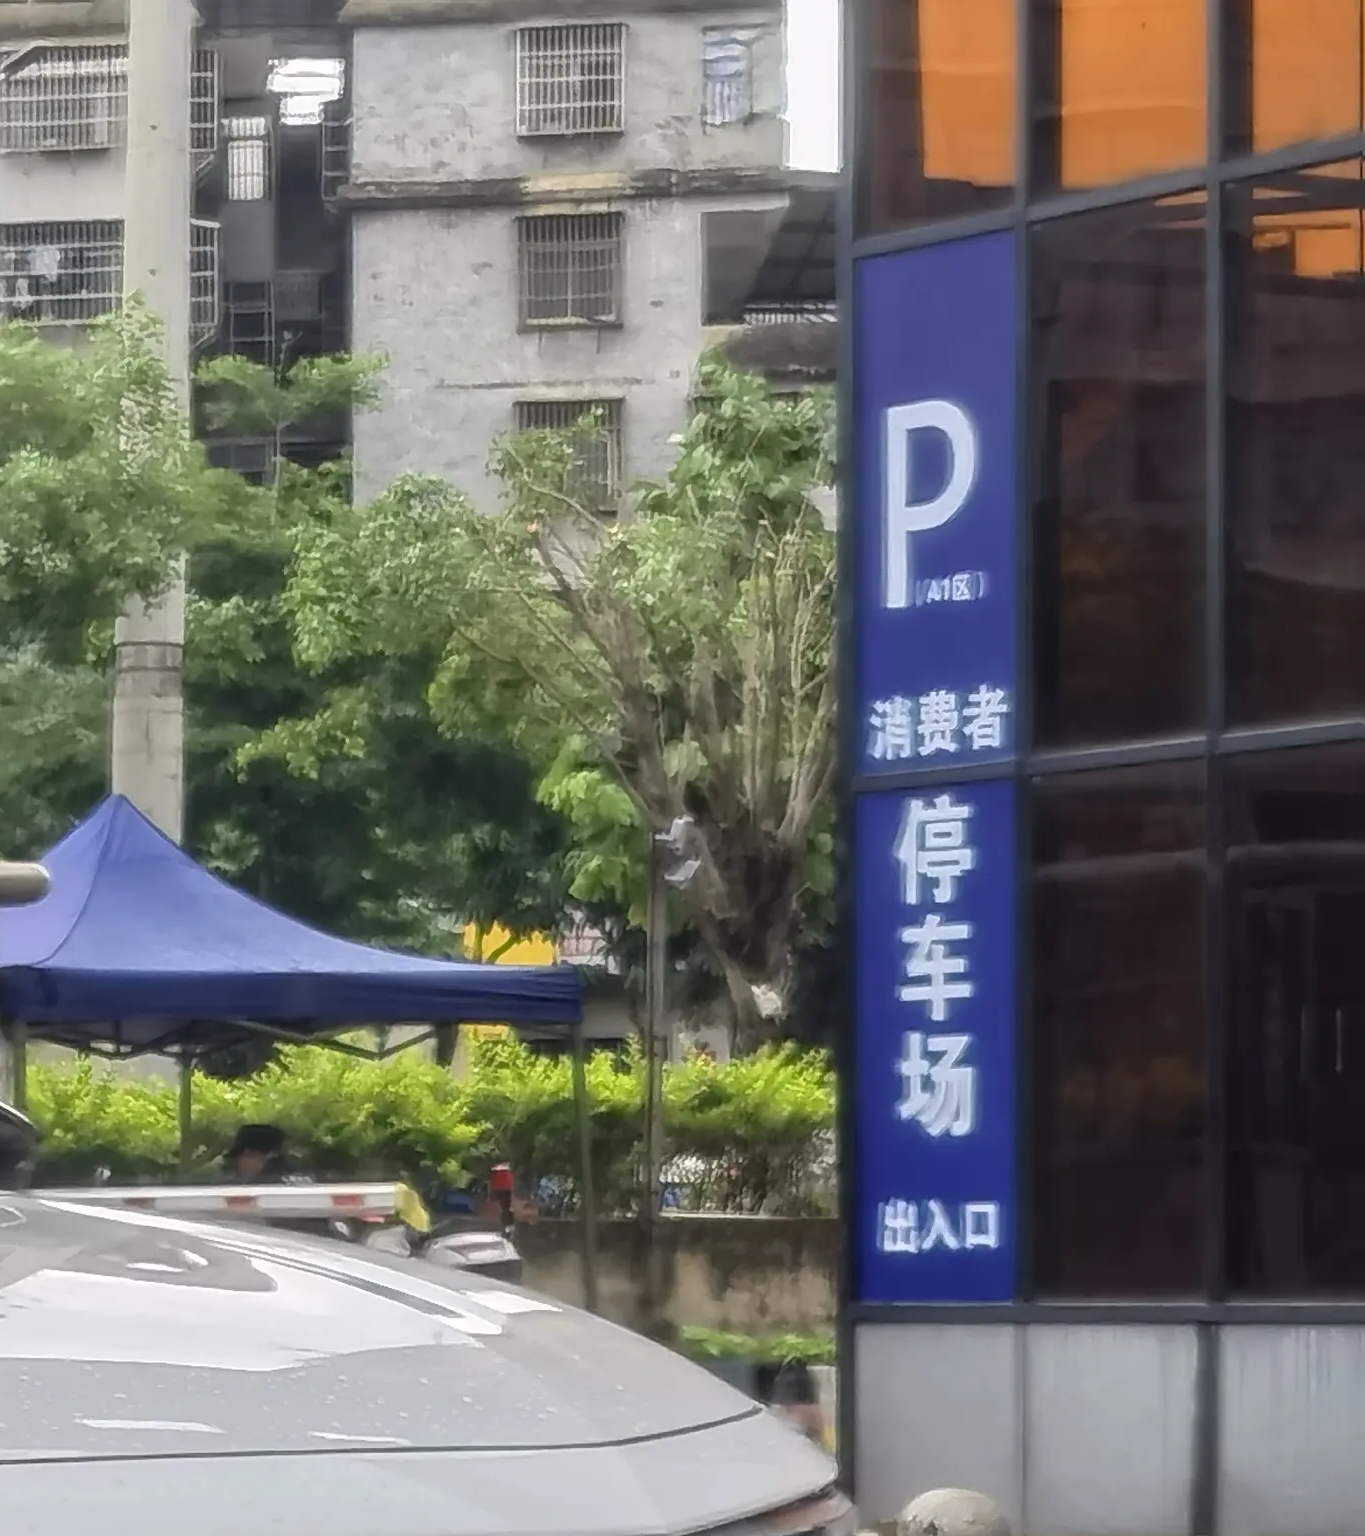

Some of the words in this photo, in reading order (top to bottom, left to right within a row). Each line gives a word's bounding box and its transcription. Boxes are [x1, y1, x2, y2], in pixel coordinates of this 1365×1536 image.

[884, 400, 975, 608] P
[868, 685, 1009, 761] 消费者
[896, 795, 977, 1137] 停车场
[877, 1198, 1000, 1254] 出入口
